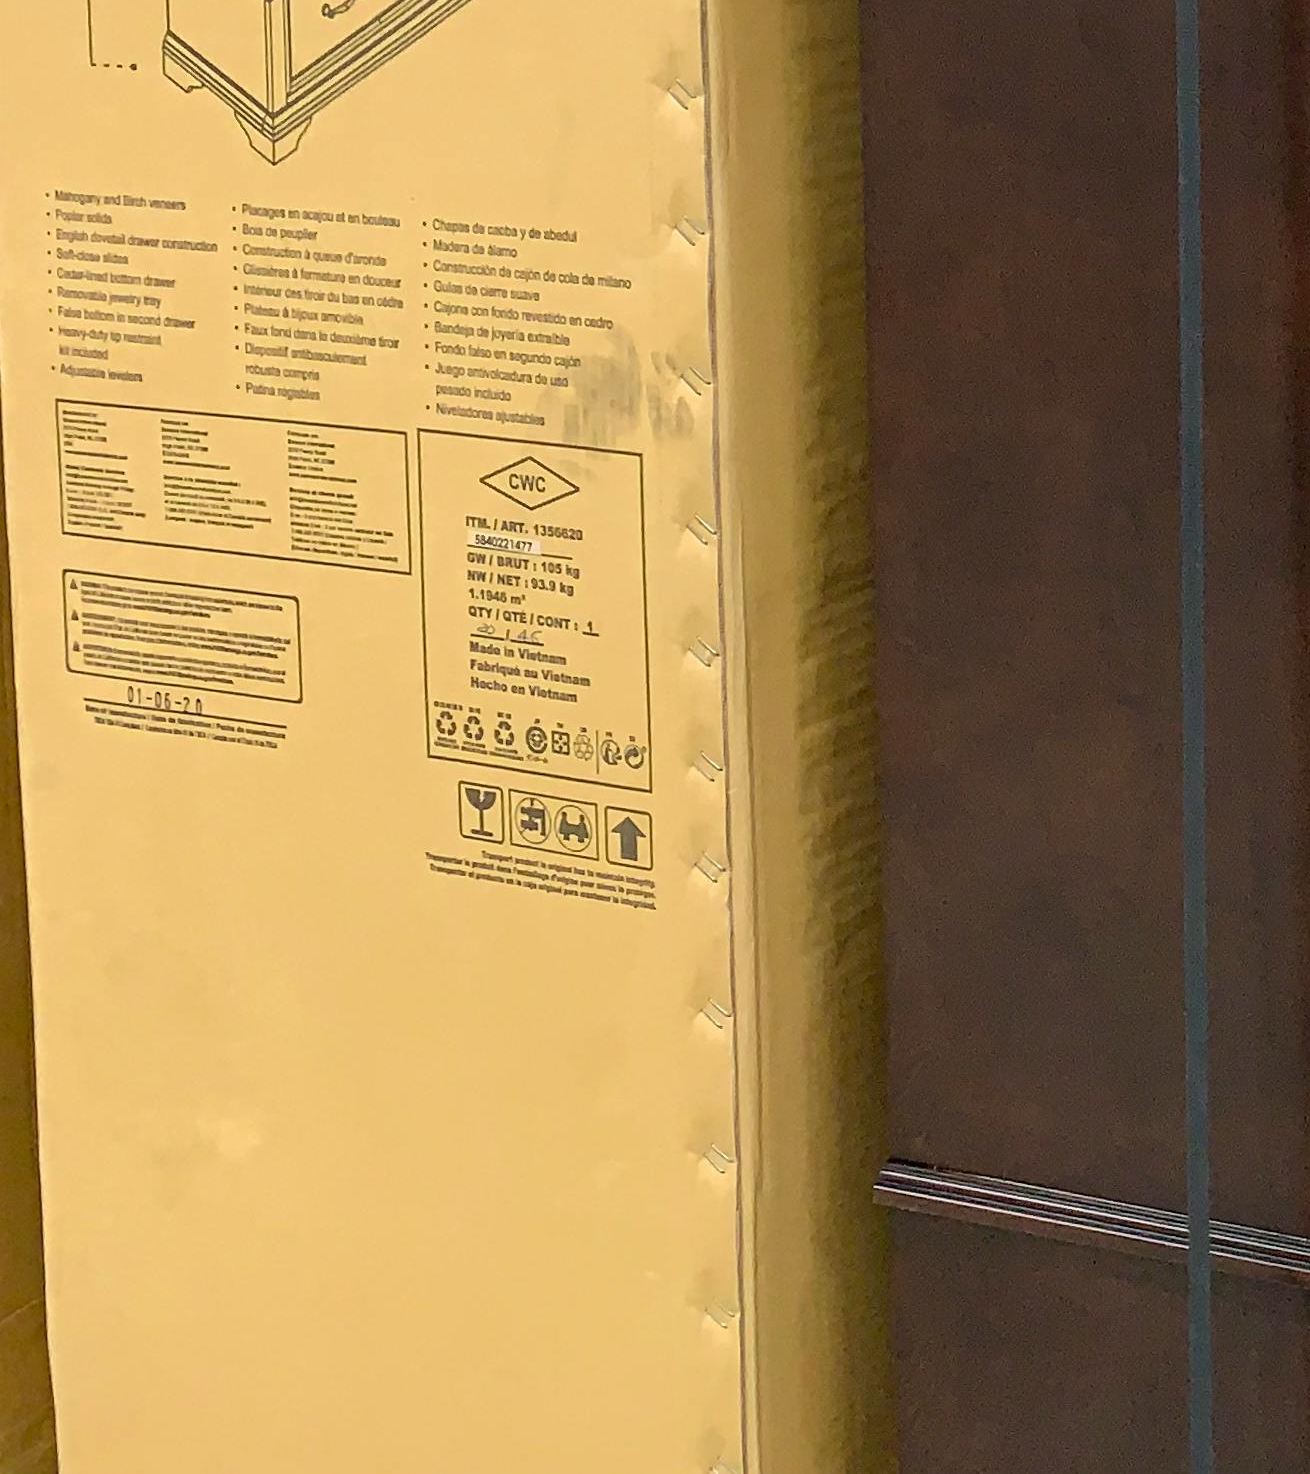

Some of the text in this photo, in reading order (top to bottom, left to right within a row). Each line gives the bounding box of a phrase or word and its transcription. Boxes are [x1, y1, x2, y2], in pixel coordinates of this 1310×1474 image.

[508, 473, 546, 493] CWC
[466, 515, 490, 530] ITM.
[500, 518, 529, 535] ART.
[533, 523, 583, 541] 1356620
[474, 533, 533, 552] 5840221477
[467, 552, 486, 565] GW
[497, 554, 529, 571] BRUT
[541, 560, 562, 575] 105
[565, 563, 580, 579] kg
[467, 570, 486, 584] NW
[497, 573, 521, 588] NET
[531, 578, 556, 593] 93.9
[559, 580, 574, 597] kg
[468, 605, 493, 619] QTY
[537, 614, 570, 630] CONT
[470, 640, 567, 666] Made in Vietnam
[471, 676, 577, 703] Hecho en Vietnam
[524, 667, 538, 679] au
[541, 668, 591, 687] Vietnam
